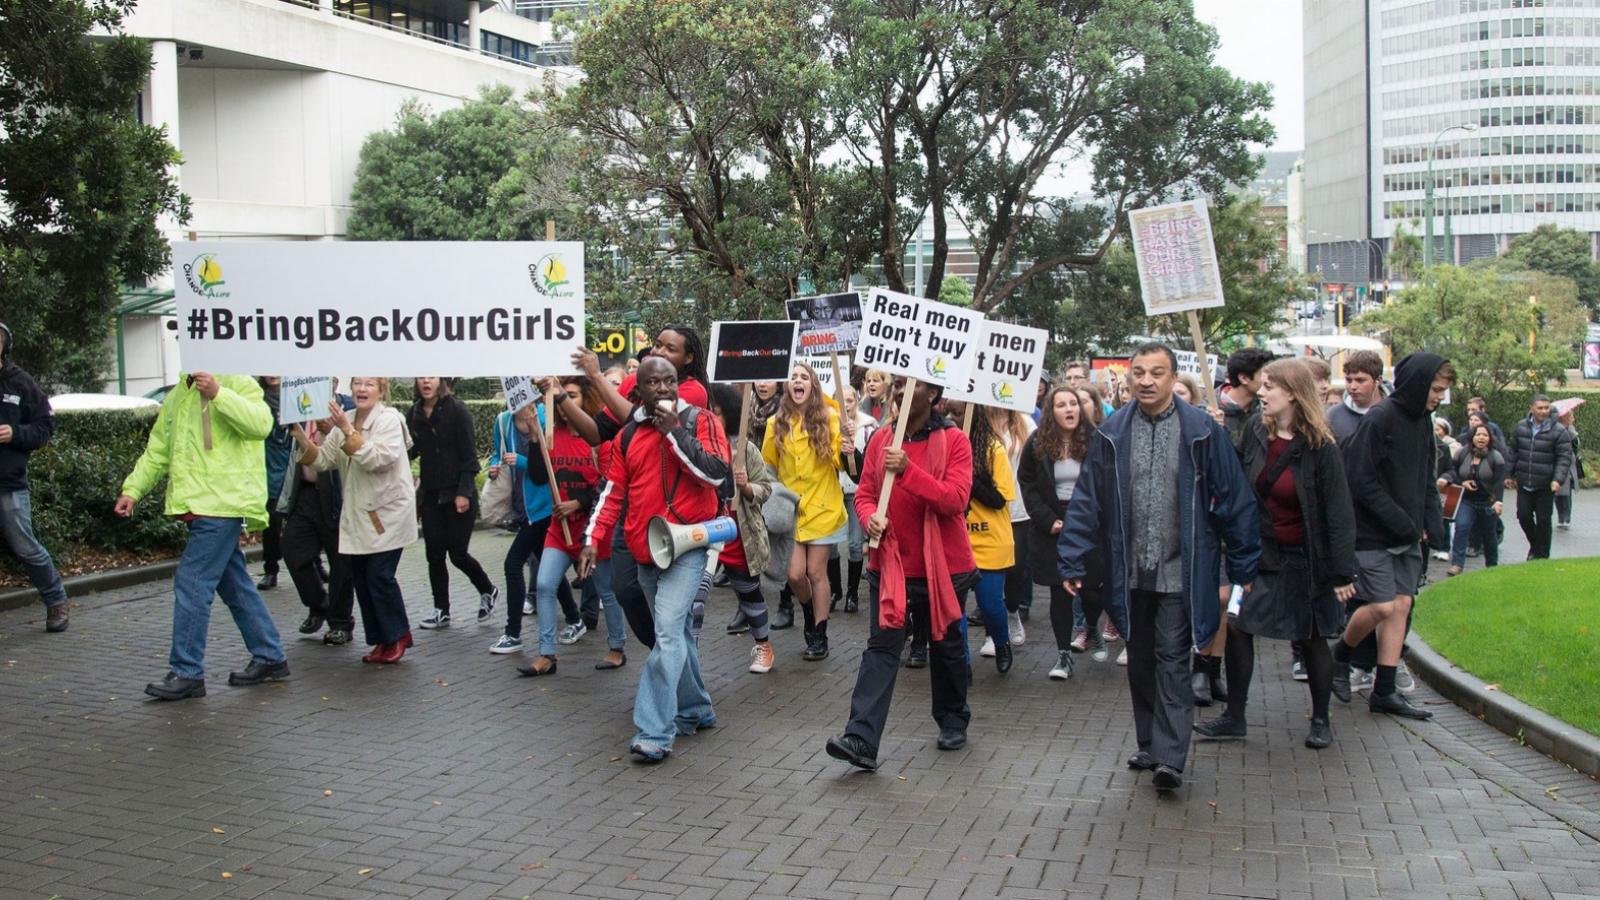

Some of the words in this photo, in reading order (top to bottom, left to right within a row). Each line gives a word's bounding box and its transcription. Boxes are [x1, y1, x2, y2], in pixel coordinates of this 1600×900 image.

[1148, 259, 1195, 277] GIRLS
[183, 263, 204, 296] CHANGE
[528, 263, 548, 296] CHANGE
[873, 294, 920, 321] Real
[925, 310, 970, 333] men
[187, 307, 575, 349] #BringBackOurGirls
[801, 333, 837, 347] BRING
[868, 319, 922, 347] don't
[927, 331, 967, 360] buy
[988, 332, 1036, 354] men
[810, 360, 832, 369] men
[863, 343, 911, 369] girls
[1174, 352, 1191, 362] eal
[1193, 356, 1213, 365] mn
[817, 373, 832, 383] uy
[992, 354, 1033, 382] buy
[509, 389, 528, 411] girls
[550, 456, 595, 466] UBUNT
